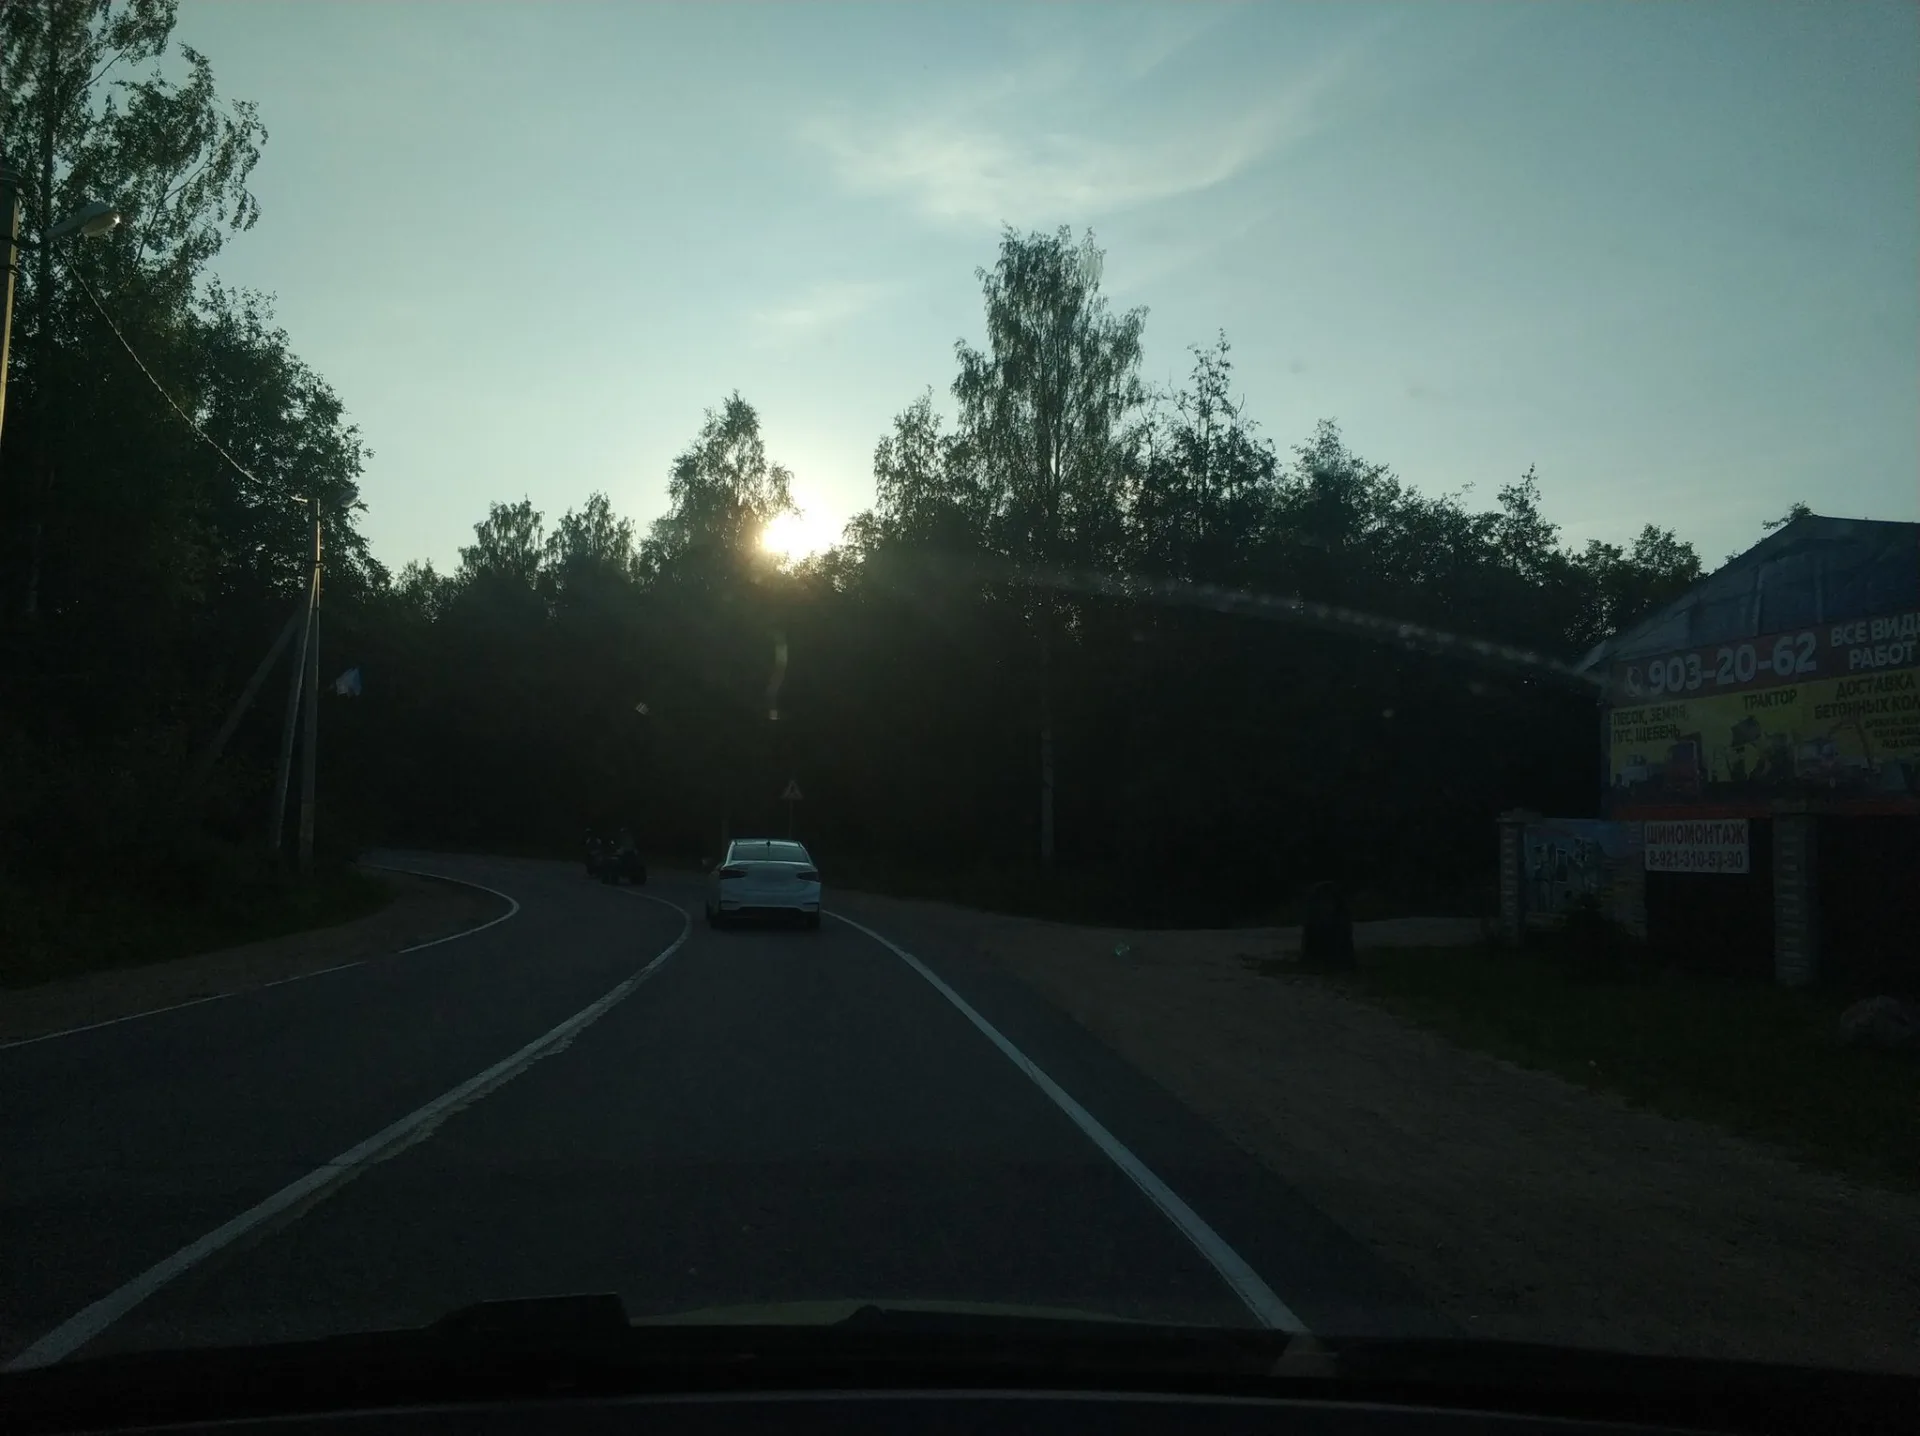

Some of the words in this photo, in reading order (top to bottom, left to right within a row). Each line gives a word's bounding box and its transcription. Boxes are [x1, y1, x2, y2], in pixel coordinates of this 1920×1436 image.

[1830, 621, 1867, 647] ВСЕ
[1649, 632, 1816, 695] 903-20-62
[1849, 640, 1917, 669] РАБОТ
[1835, 672, 1915, 701] ДОСТАВКА
[1744, 689, 1797, 711] ТРАКТОР
[1814, 698, 1889, 720] БЕТОННЫХ
[1647, 823, 1745, 845] ШИНОМОНТАЖ
